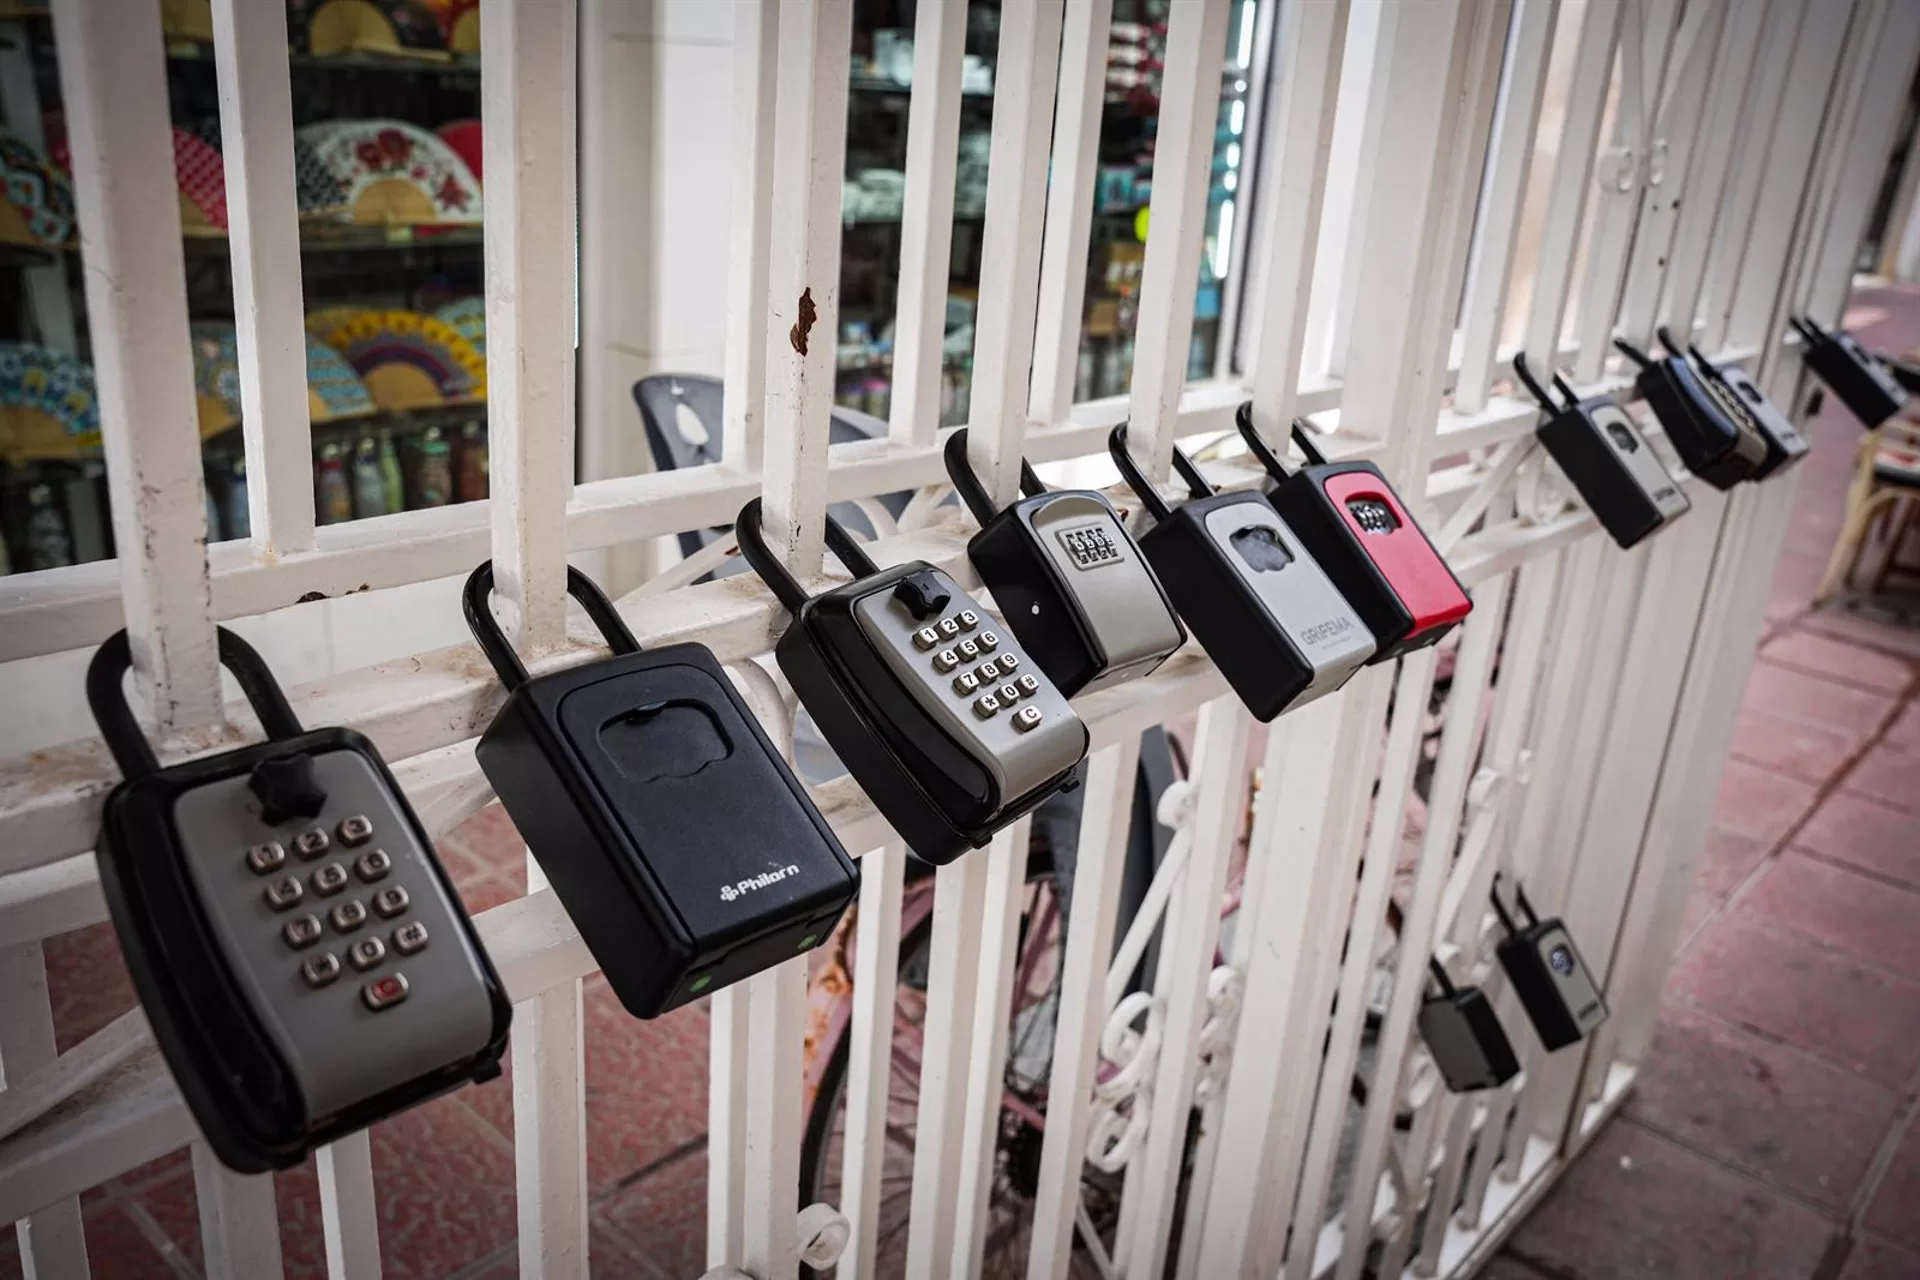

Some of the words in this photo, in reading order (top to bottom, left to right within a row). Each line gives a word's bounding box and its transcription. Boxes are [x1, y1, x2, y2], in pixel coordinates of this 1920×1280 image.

[944, 620, 956, 631] 2
[964, 611, 975, 622] 3
[945, 651, 956, 662] 4
[965, 641, 976, 652] 5
[984, 632, 996, 643] 6
[984, 664, 996, 675] 8
[1005, 654, 1016, 665] 9
[1005, 686, 1016, 697] 0
[1025, 708, 1037, 719] C
